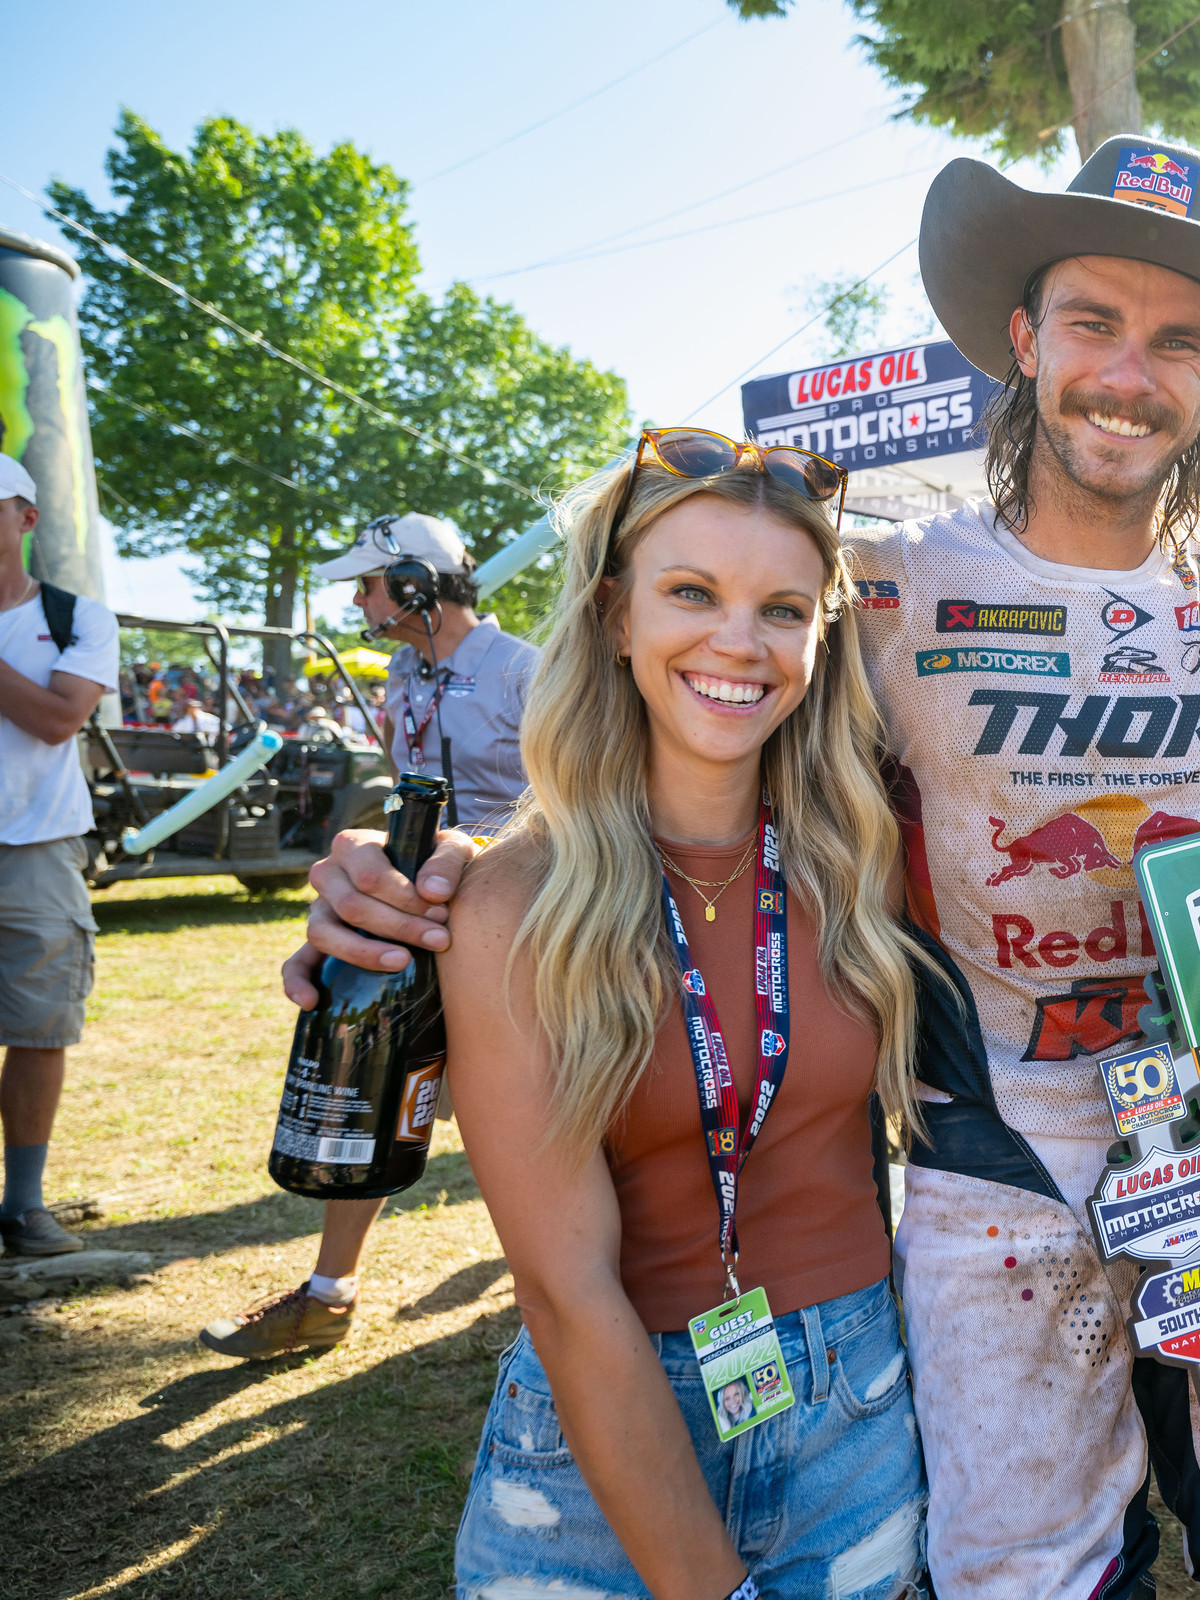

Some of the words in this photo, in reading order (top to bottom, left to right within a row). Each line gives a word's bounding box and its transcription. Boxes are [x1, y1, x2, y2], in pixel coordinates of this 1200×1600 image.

[1115, 171, 1157, 191] Red
[1155, 175, 1193, 205] Bull
[797, 359, 874, 404] LUCAS
[879, 351, 918, 386] OIL
[828, 393, 888, 417] PRO
[757, 391, 973, 455] MOTOCROSS
[832, 428, 973, 464] PIONSHIP
[957, 651, 1060, 673] MOTOREX
[1098, 672, 1170, 684] RENTHAL
[1011, 770, 1043, 786] THE
[1049, 771, 1095, 787] FIRST
[1102, 772, 1135, 787] THE
[763, 824, 779, 872] 2022
[761, 892, 774, 910] 50
[991, 901, 1127, 969] Red
[757, 948, 766, 961] OIL
[757, 964, 767, 993] LUCAS
[771, 932, 783, 1013] MOTOCROSS
[691, 1016, 717, 1109] MOTOCROSS
[712, 1034, 727, 1066] LUCAS
[719, 1067, 731, 1085] OIL
[1116, 1057, 1169, 1103] 50
[334, 1086, 360, 1097] WINE
[750, 1080, 775, 1137] 2022
[1121, 1117, 1136, 1126] PRO
[1138, 1103, 1181, 1120] MOTOCROSS
[1132, 1112, 1174, 1129] CHAMPIONSHIP
[1135, 1104, 1154, 1115] LUCAS
[1154, 1100, 1165, 1108] OIL
[720, 1131, 734, 1152] 50
[719, 1171, 735, 1214] 202
[1116, 1164, 1173, 1198] LUCAS
[1151, 1189, 1184, 1204] PRO
[1162, 1234, 1185, 1249] AMA
[1184, 1230, 1198, 1240] PRO
[709, 1309, 753, 1340] GUEST
[713, 1322, 758, 1349] PADDOCK
[709, 1336, 777, 1390] 2022
[756, 1365, 776, 1385] 50
